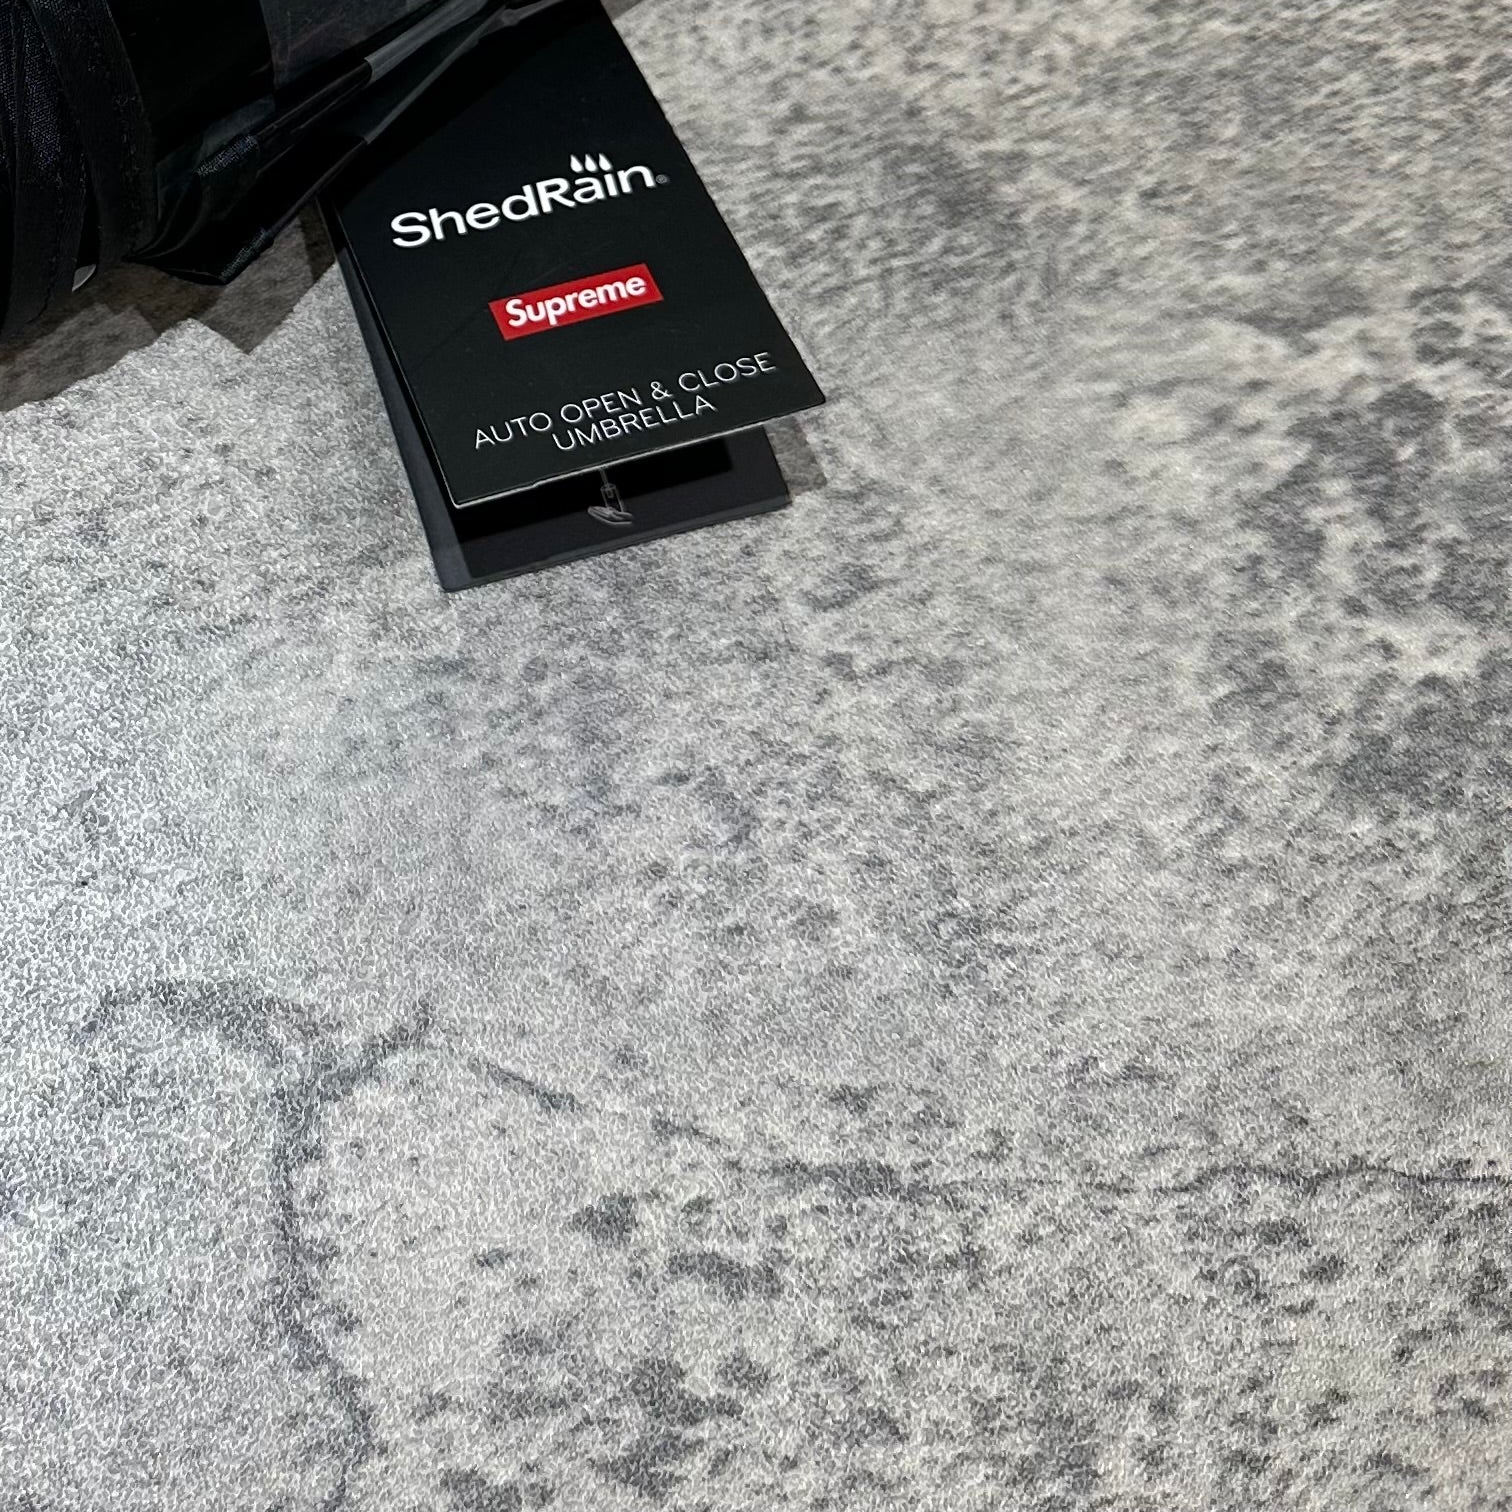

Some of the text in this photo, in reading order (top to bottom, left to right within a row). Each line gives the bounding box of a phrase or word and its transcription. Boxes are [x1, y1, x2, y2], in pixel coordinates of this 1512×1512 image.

[504, 275, 648, 328] Supreme
[473, 350, 778, 450] AUTO OPEN & CLOSE
[550, 394, 719, 452] UMBRELLA
